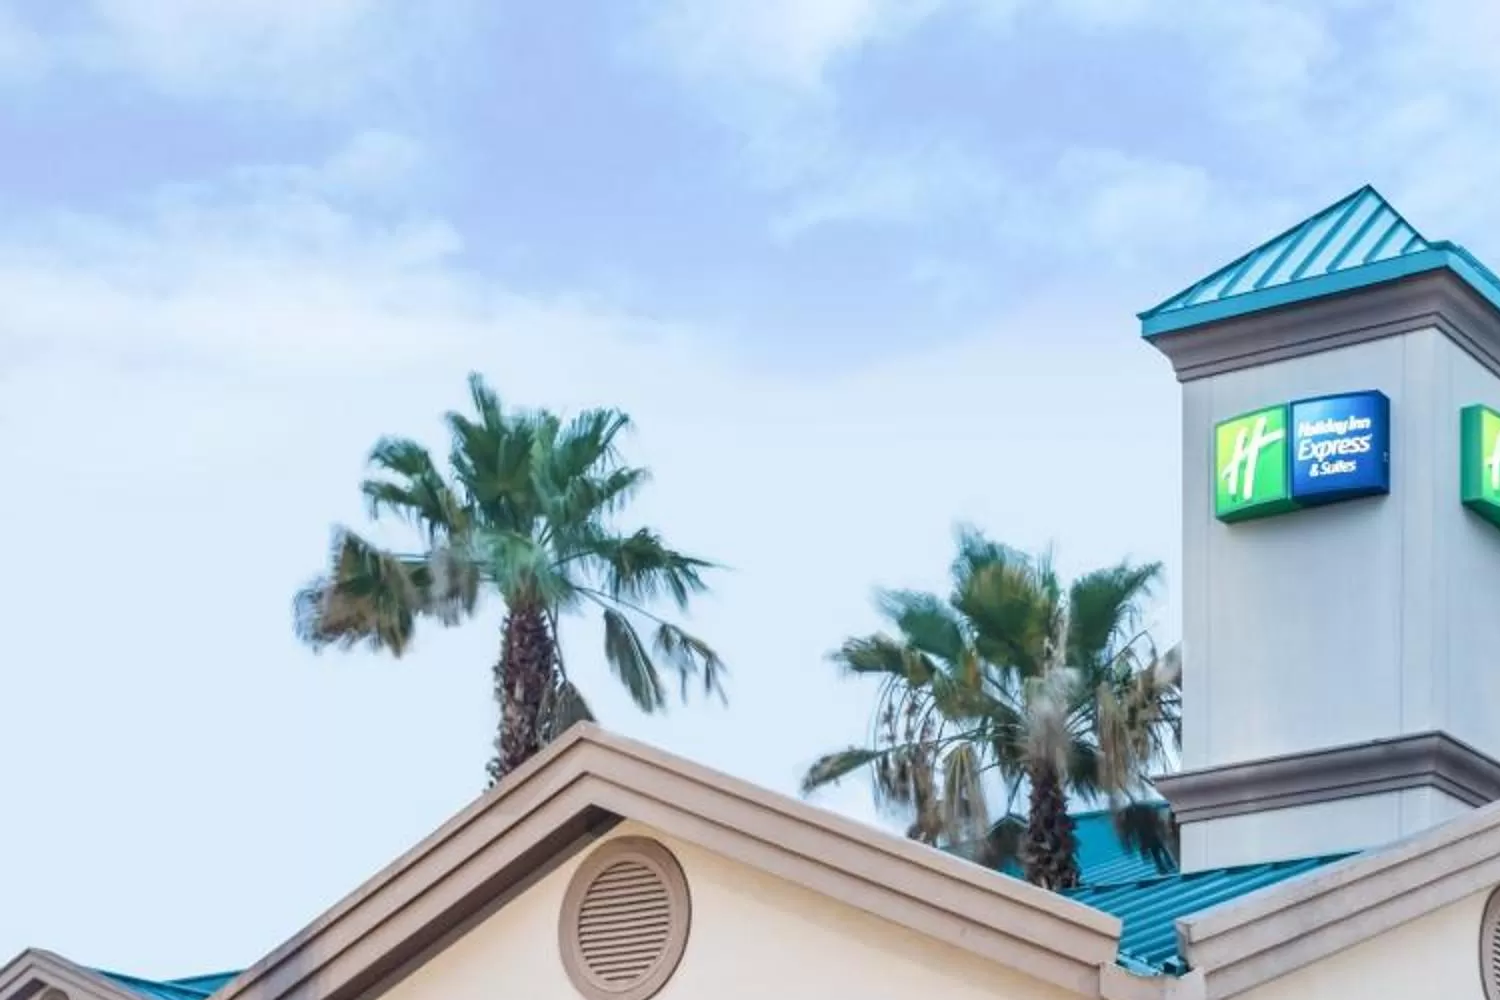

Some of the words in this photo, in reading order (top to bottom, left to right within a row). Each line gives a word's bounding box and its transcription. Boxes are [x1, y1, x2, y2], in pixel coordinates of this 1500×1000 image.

[1348, 414, 1372, 431] Inn
[1297, 432, 1374, 463] Express
[1320, 459, 1357, 476] Suites
